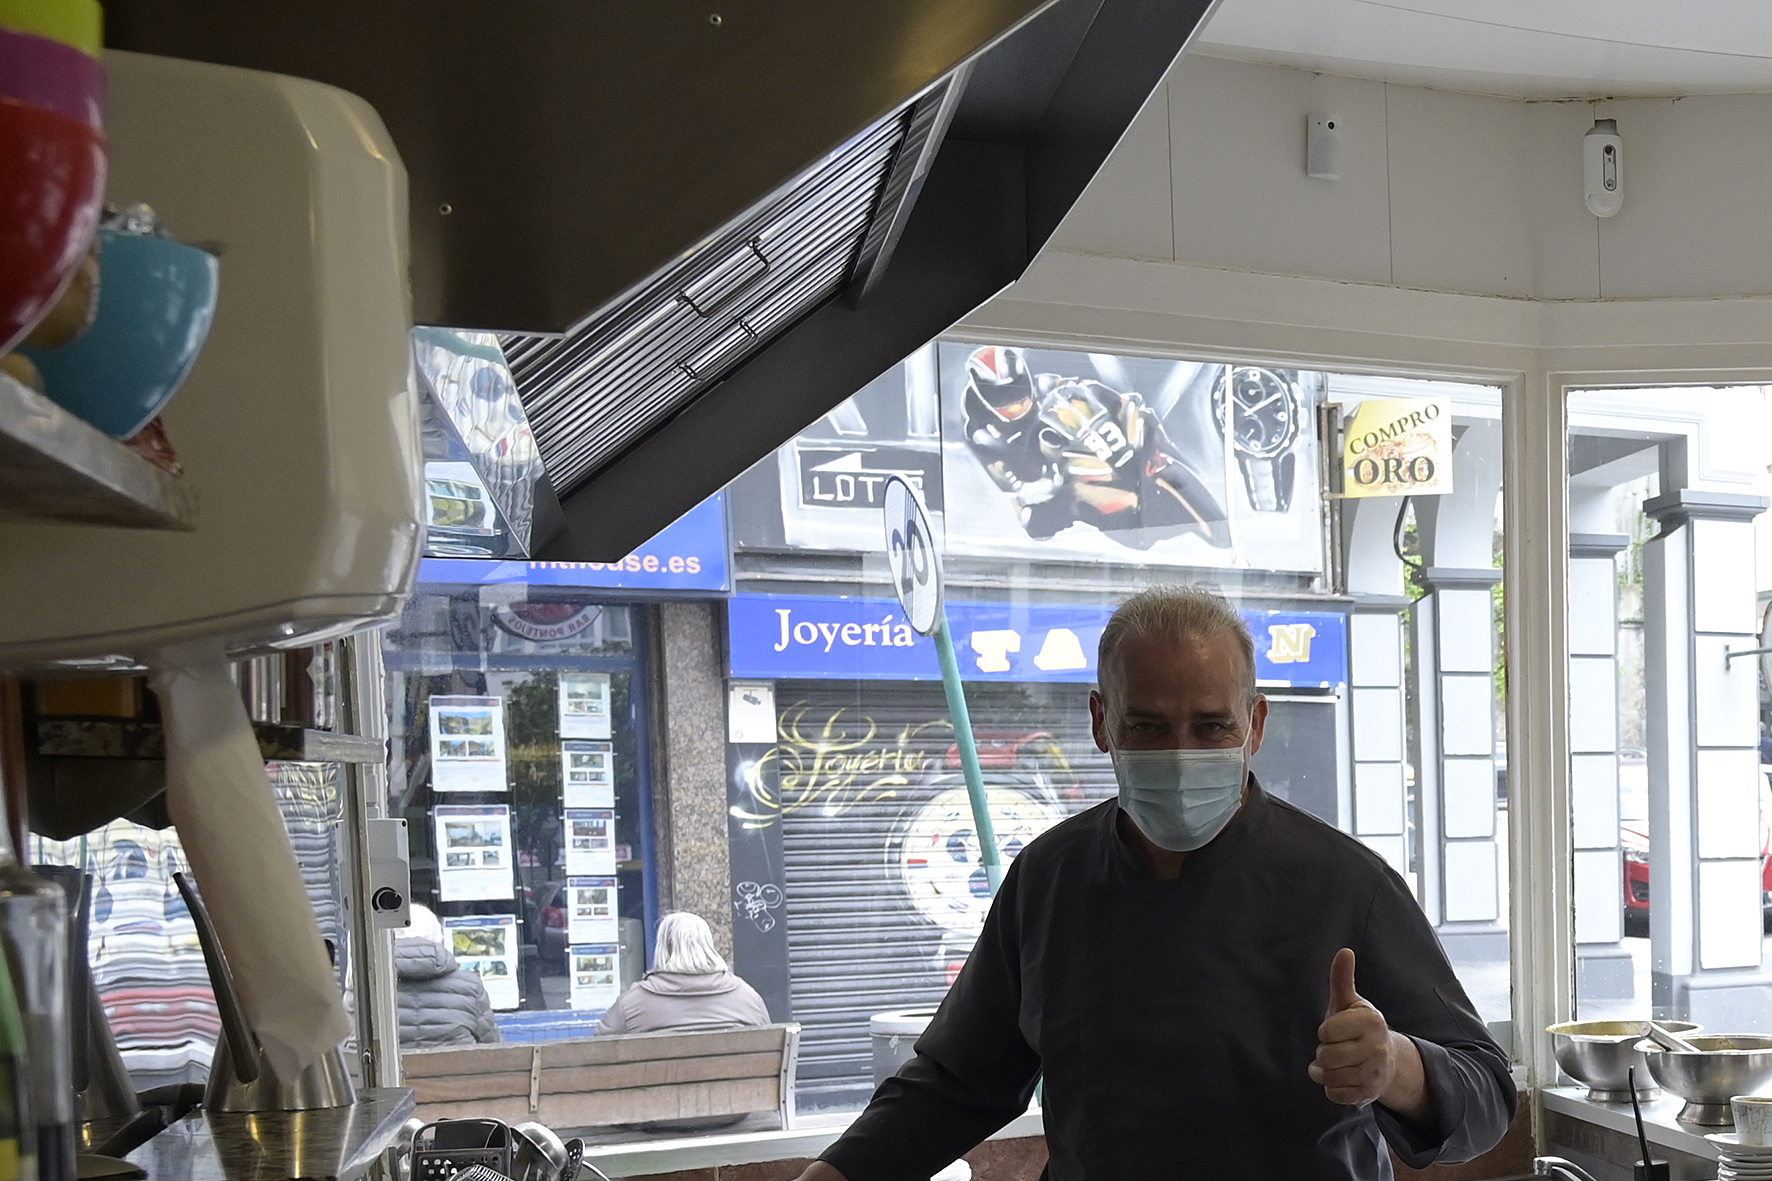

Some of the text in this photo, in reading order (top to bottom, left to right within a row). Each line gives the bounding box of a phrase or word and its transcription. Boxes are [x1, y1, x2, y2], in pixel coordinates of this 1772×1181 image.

[1350, 404, 1440, 455] COMPRO
[1353, 456, 1435, 485] ORO
[892, 519, 929, 595] 20
[774, 608, 915, 653] Joyería
